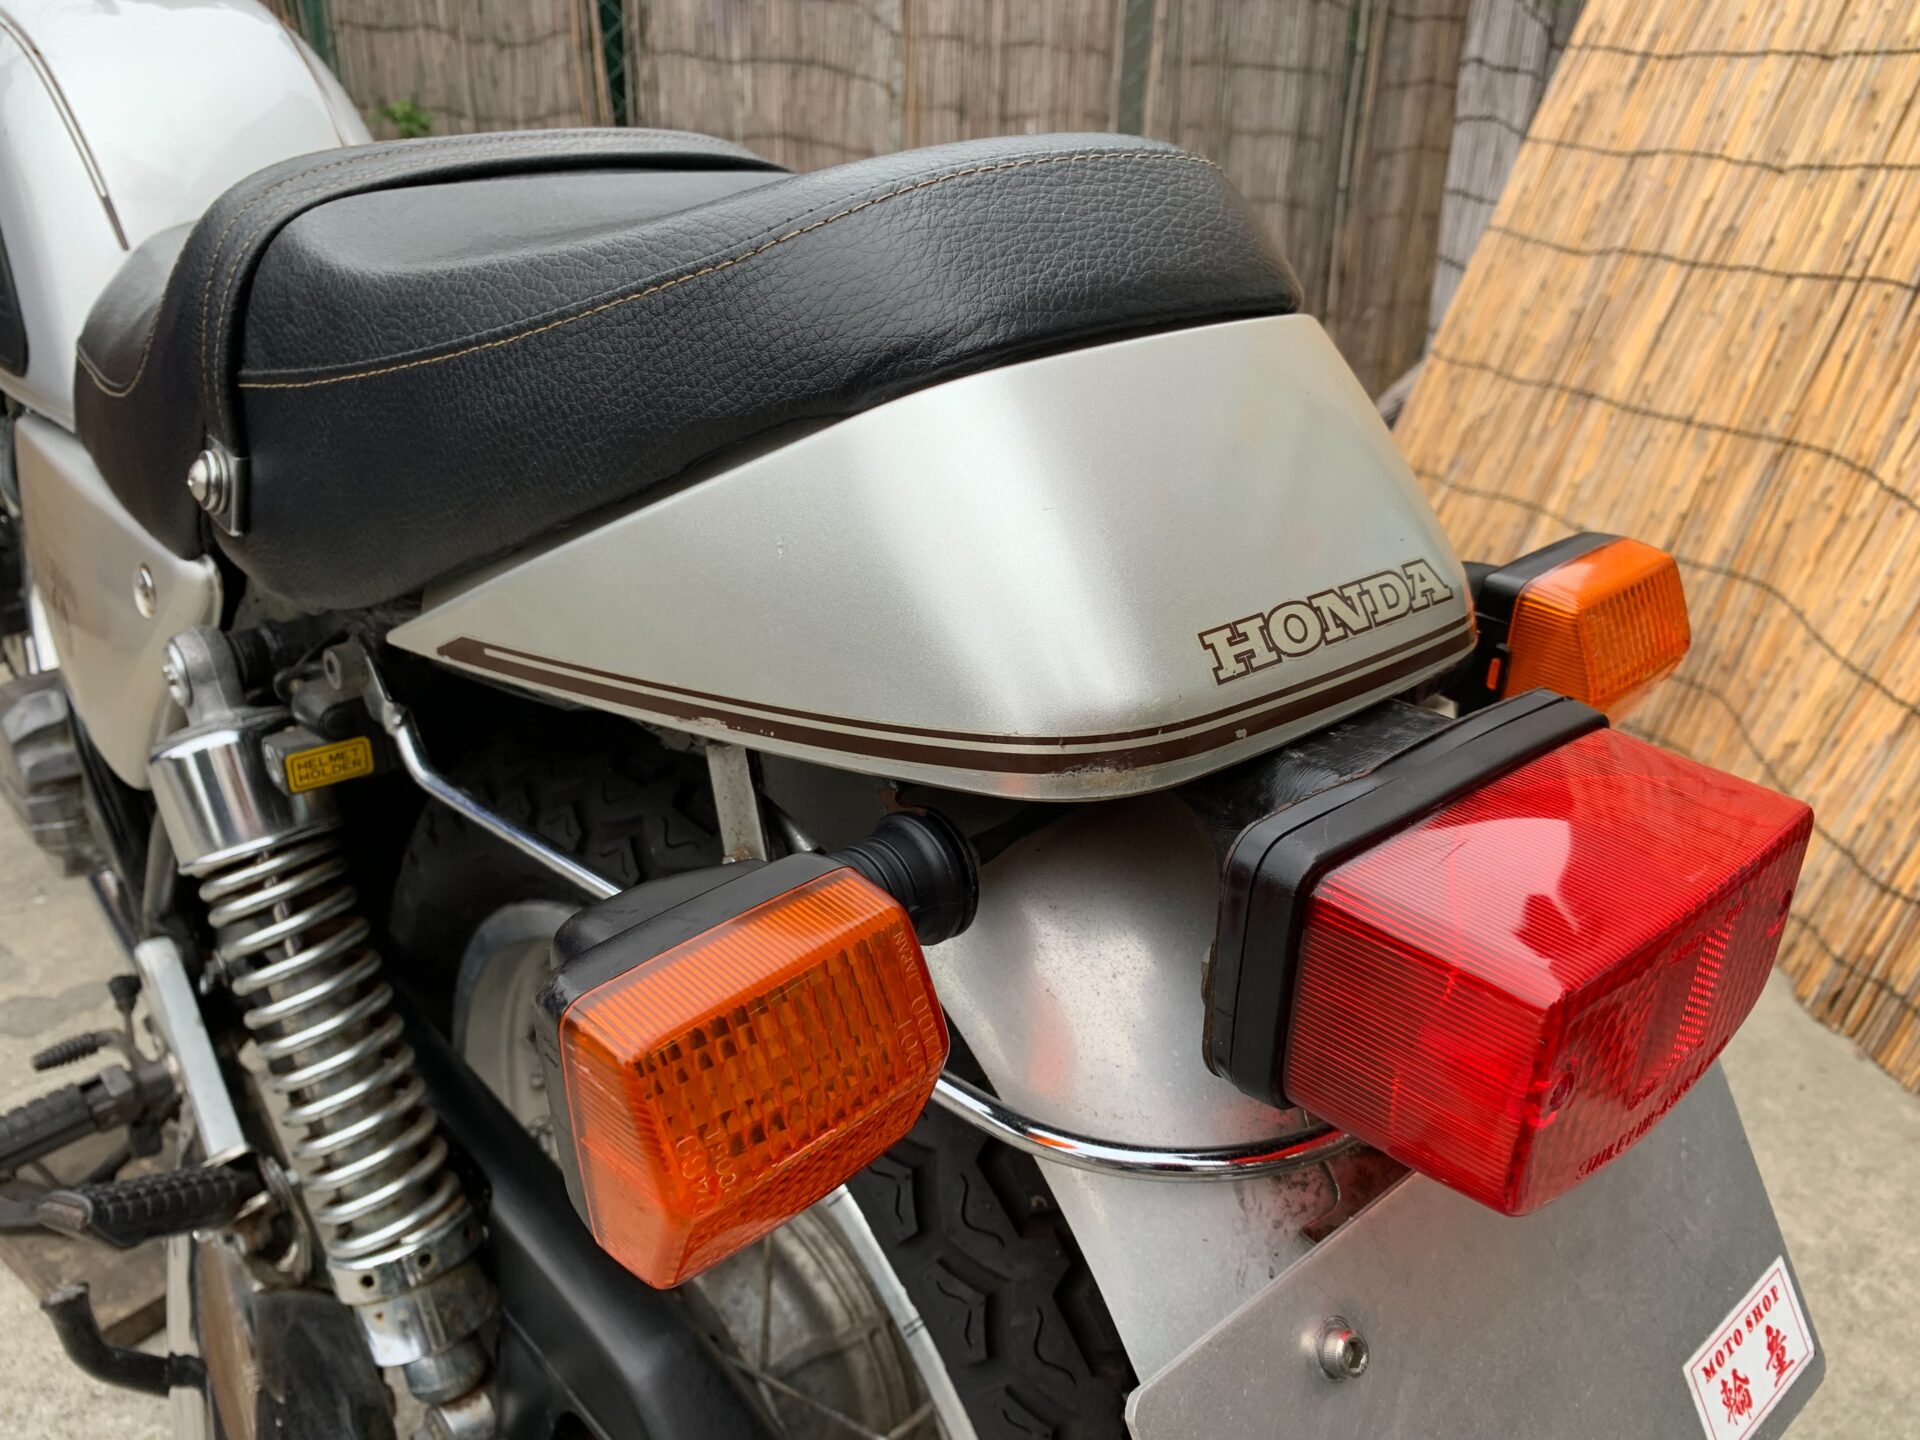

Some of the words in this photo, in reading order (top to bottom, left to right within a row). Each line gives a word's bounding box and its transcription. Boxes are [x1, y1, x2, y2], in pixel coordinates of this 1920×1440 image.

[1198, 558, 1454, 686] HONDA
[297, 747, 360, 771] HELMET
[299, 760, 362, 782] HOLDER
[1701, 1328, 1743, 1384] MOTO
[1745, 1285, 1780, 1333] SHOP
